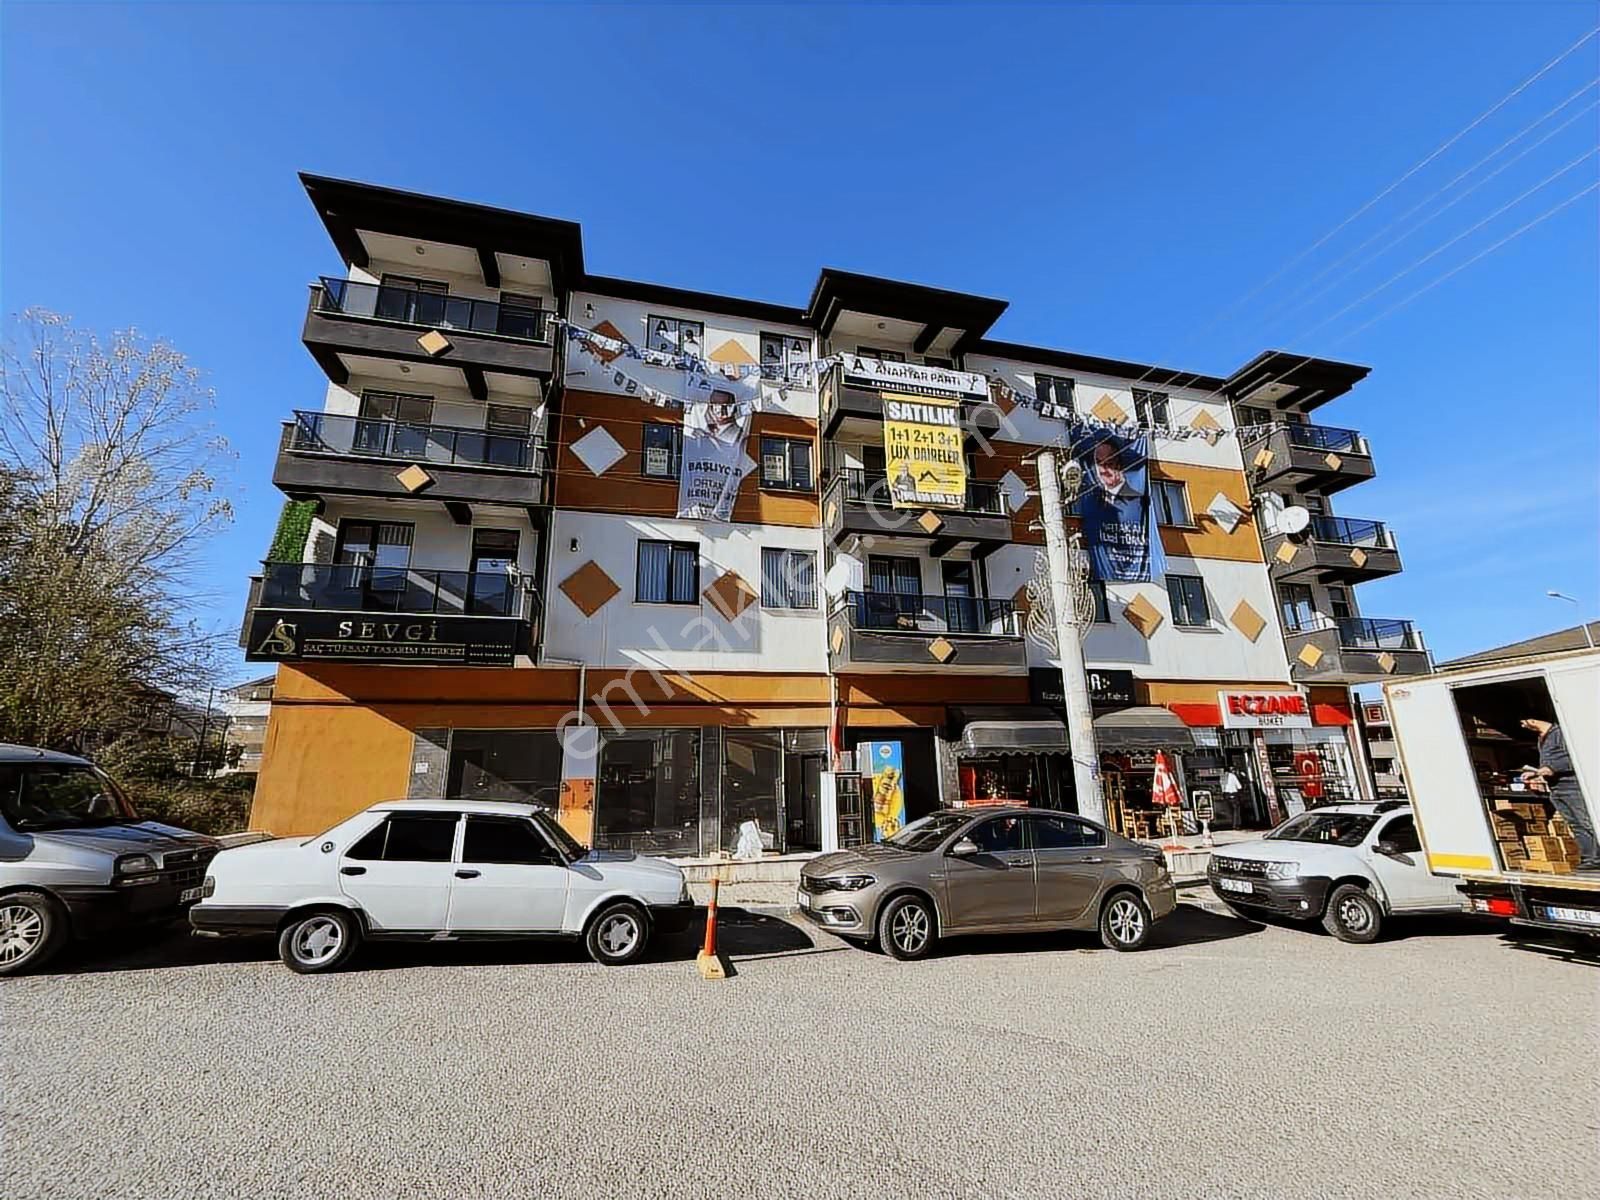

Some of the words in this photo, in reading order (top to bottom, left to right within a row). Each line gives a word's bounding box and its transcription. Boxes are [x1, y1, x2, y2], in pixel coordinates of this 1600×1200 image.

[888, 402, 956, 425] SATILIK
[890, 427, 910, 442] 1+1
[913, 429, 935, 444] 2+1
[938, 432, 959, 447] 3+1
[890, 441, 910, 460] LÜX
[688, 461, 743, 477] BAŞLIYO
[338, 620, 439, 641] SEVGİ
[1227, 695, 1307, 715] ECZANE
